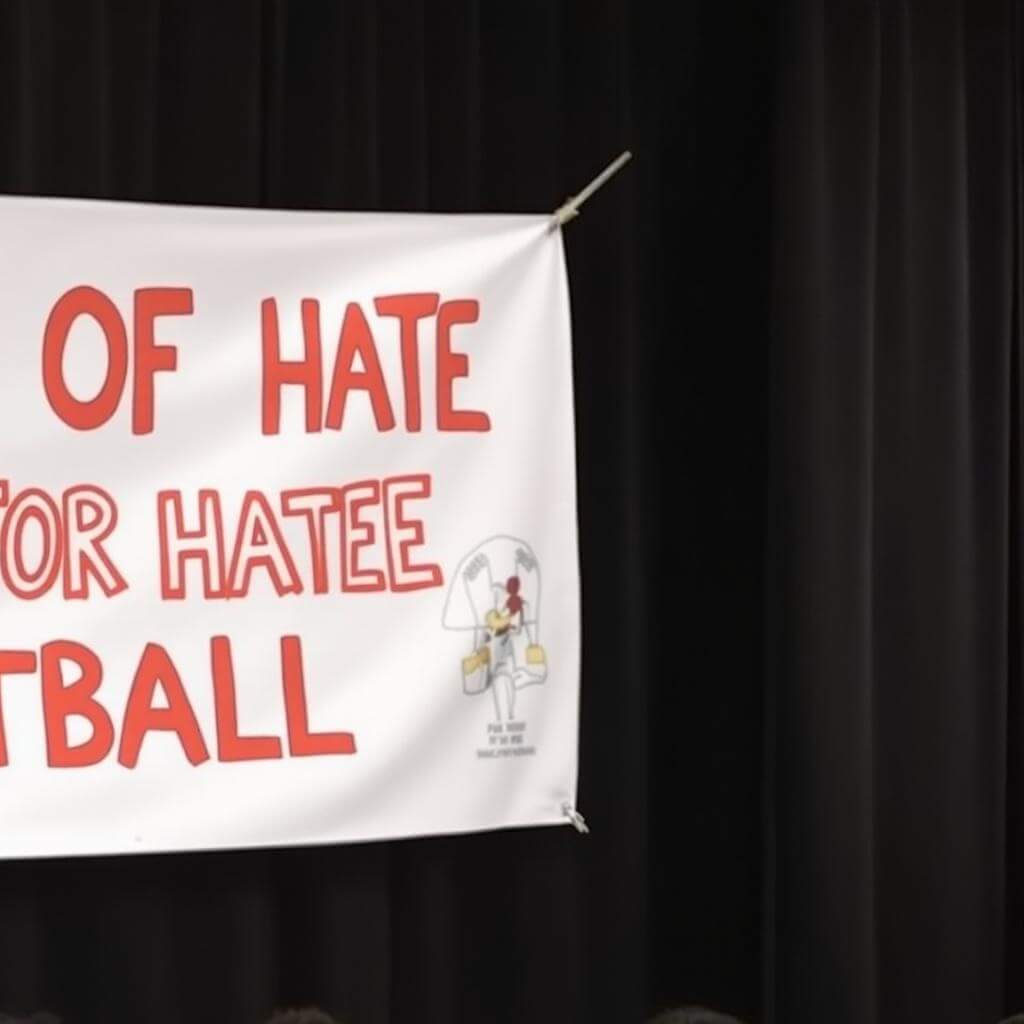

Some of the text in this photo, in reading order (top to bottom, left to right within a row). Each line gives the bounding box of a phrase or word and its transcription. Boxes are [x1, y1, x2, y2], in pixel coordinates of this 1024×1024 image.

[40, 283, 196, 437] OF
[260, 291, 492, 437] HATE
[156, 472, 445, 602] HATEE
